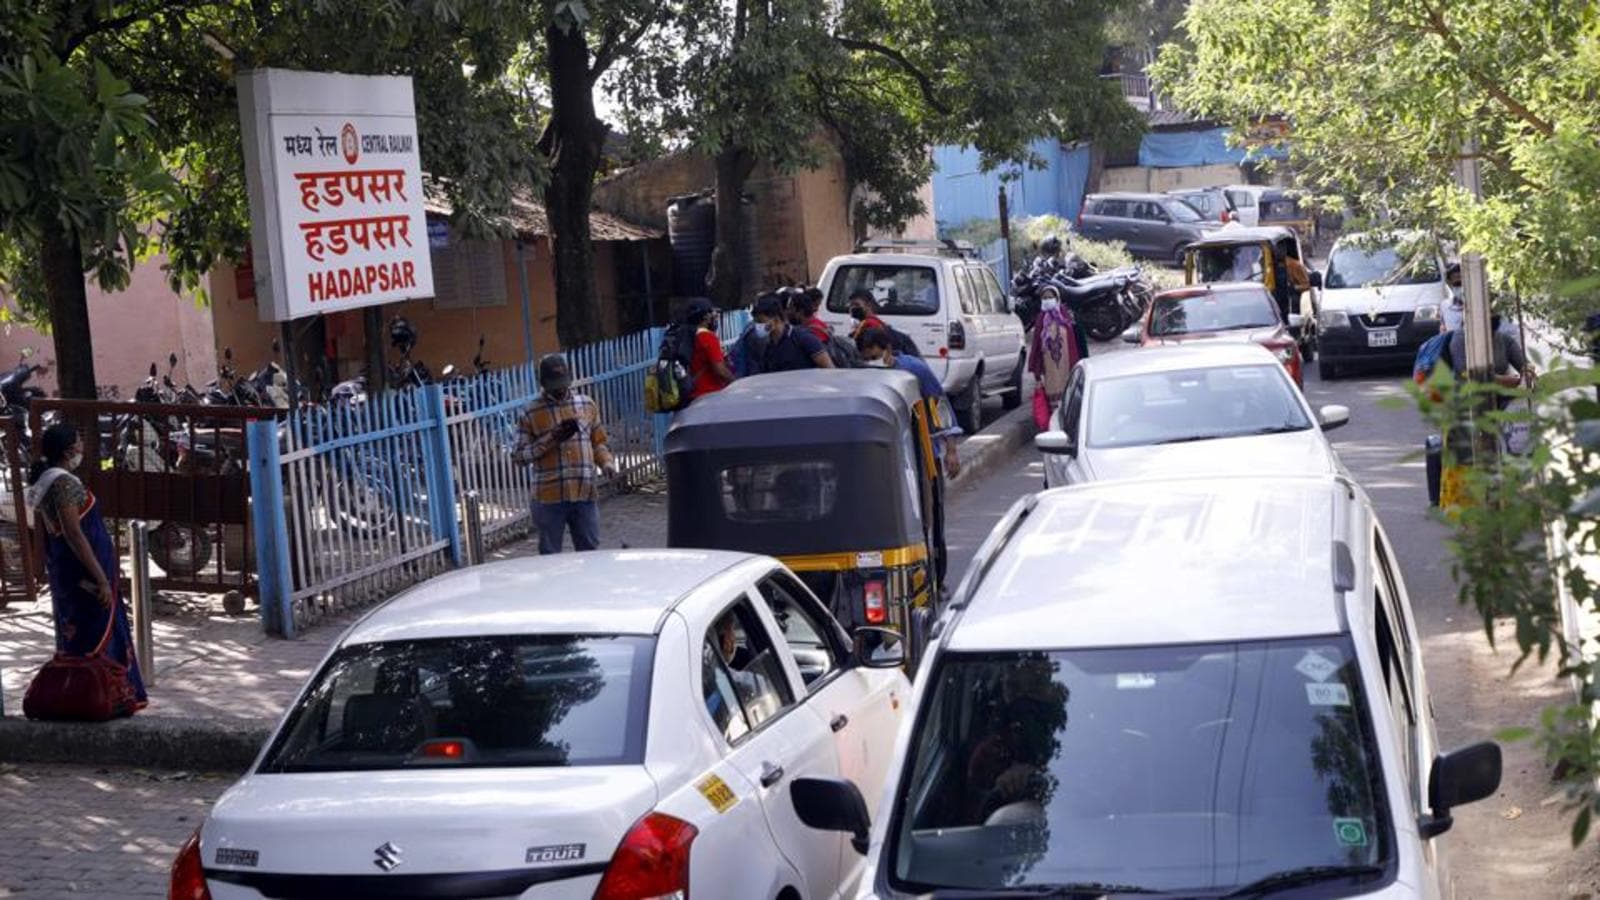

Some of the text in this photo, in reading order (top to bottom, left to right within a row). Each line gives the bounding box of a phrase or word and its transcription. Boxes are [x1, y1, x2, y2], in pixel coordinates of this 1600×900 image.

[283, 126, 338, 157] मध्य रेल
[293, 169, 408, 213] हडपसर
[298, 215, 412, 262] हडपसर
[308, 261, 416, 302] HADAPSAR
[530, 849, 581, 861] TOUR
